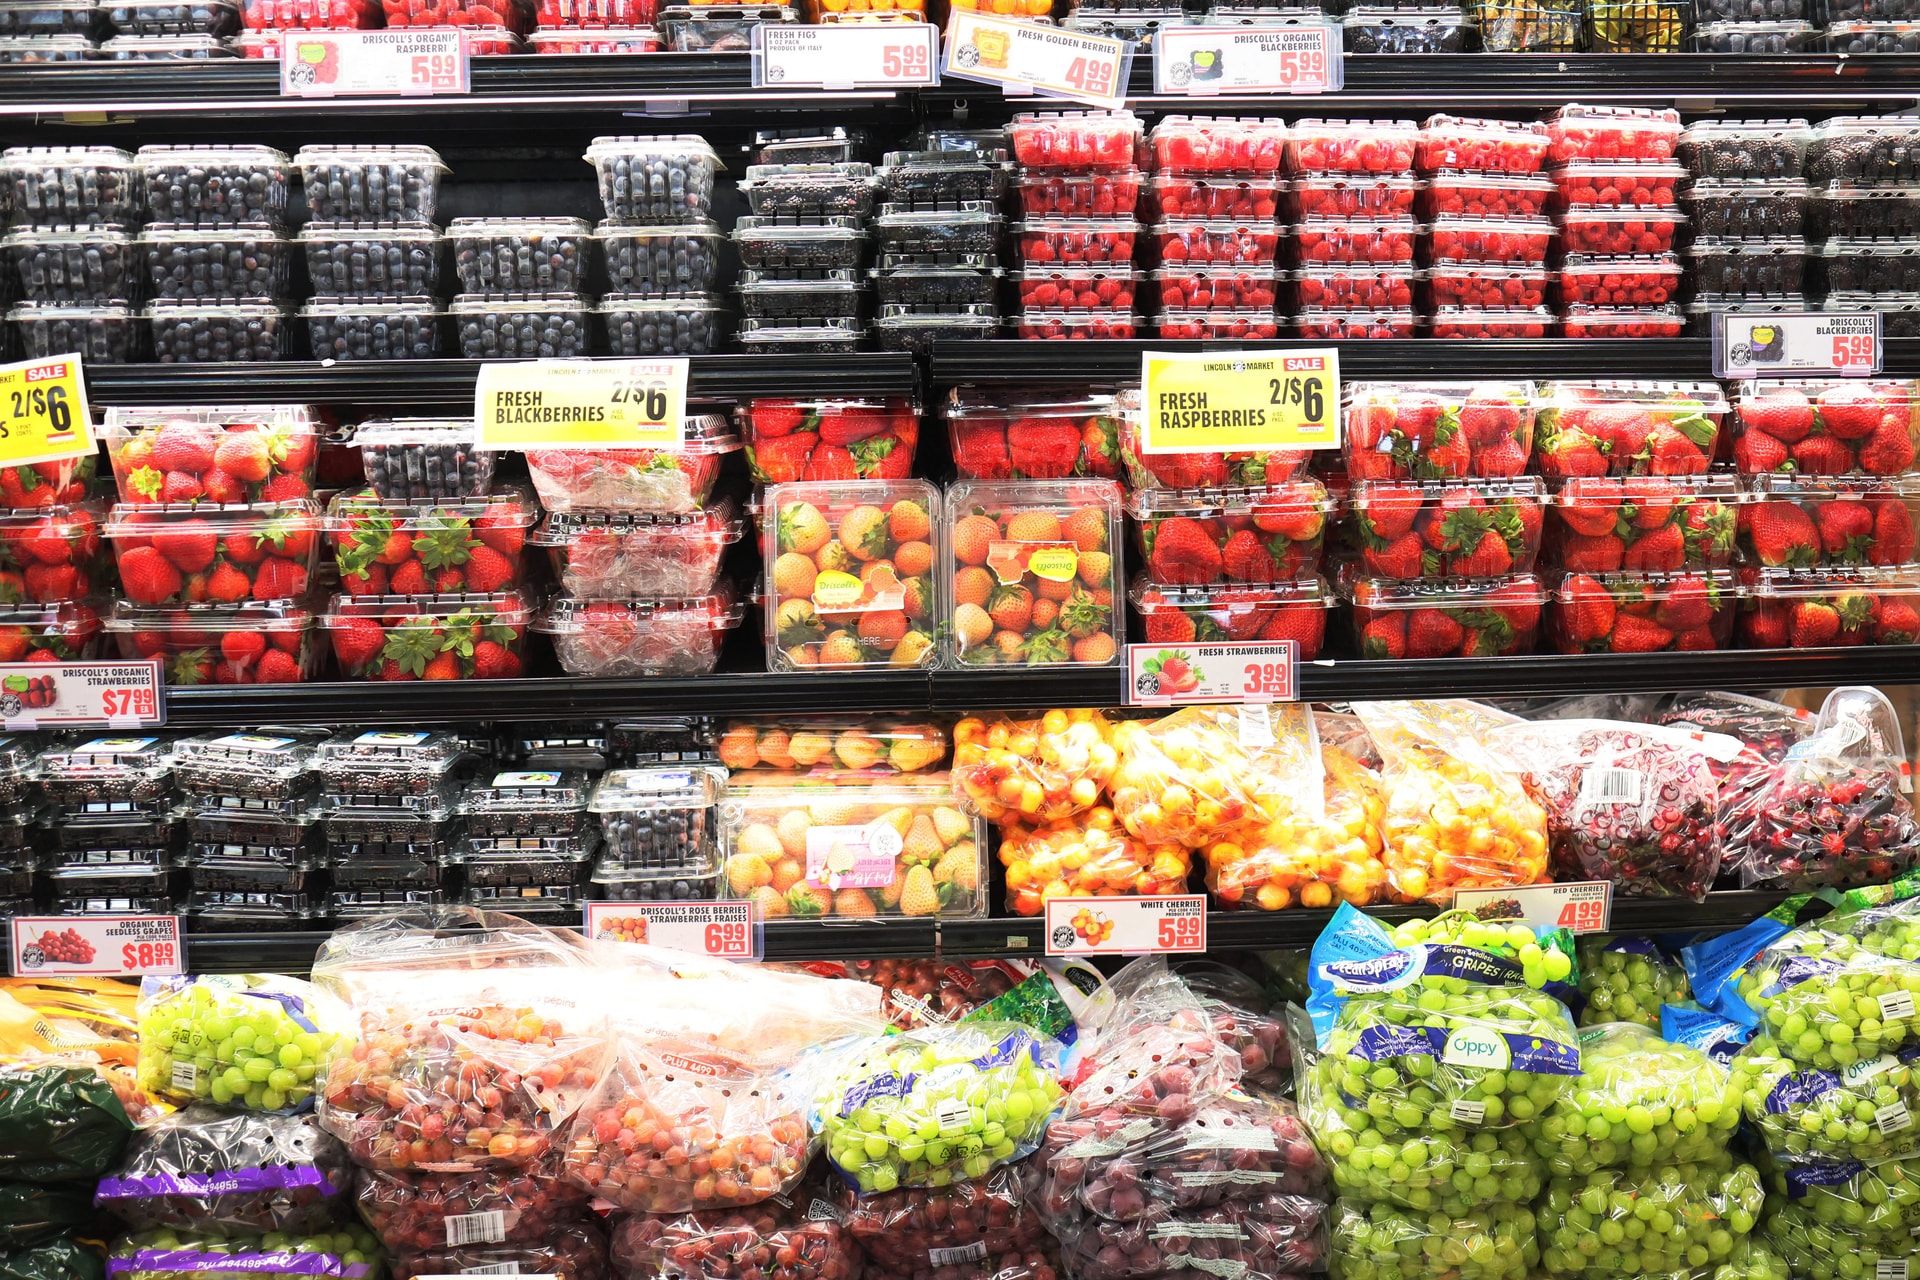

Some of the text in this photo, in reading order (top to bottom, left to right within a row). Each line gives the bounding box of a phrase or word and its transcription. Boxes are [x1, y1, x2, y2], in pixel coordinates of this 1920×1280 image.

[362, 34, 413, 44] DRISCOLL'S
[768, 31, 817, 39] FRESH FIGS
[1234, 33, 1321, 44] DRISCOLL'S ORGANIC
[1017, 28, 1117, 55] FRESH GOLDEN BERRIES
[1260, 42, 1322, 52] BLACKBERRIES
[909, 67, 921, 75] EA
[1830, 318, 1873, 327] DRISCOLL'S
[1816, 326, 1873, 335] BLACKBERRIES
[1203, 358, 1322, 372] LINCOLN MARKET SALE
[28, 365, 65, 381] SALE
[633, 366, 670, 376] SALE
[496, 391, 543, 406] FRESH
[610, 379, 668, 421] 2/$6
[1159, 392, 1208, 410] FRESH
[1269, 376, 1324, 422] 2/$6
[11, 385, 71, 432] 2/$6
[495, 406, 605, 424] BLACKBERRIES
[1160, 409, 1266, 429] RASPBERRIES
[857, 636, 881, 646] HERE
[1199, 646, 1288, 657] FRESH STRAWBERRIES
[62, 668, 150, 677] DRISCOLL'S ORGANIC
[87, 676, 151, 686] STRAWBERRIES
[1553, 885, 1604, 895] RED CHERRIES
[1140, 900, 1201, 909] WHITE CHERRIES
[640, 906, 747, 915] DRISCOLL'S ROSE BERRIES
[649, 914, 747, 923] STRAWBERRIES FRAISES
[119, 920, 173, 929] ORGANIC RED
[105, 929, 141, 937] SEEDLESS
[728, 943, 742, 951] EA
[1333, 934, 1348, 947] PLU
[1349, 943, 1369, 957] 4022
[1443, 946, 1494, 964] Green Seedless
[1452, 956, 1501, 978] GRAPES
[33, 1021, 69, 1049] ORGANIC
[643, 1026, 679, 1041] grapes
[1454, 1036, 1497, 1057] Oppy
[689, 1061, 712, 1075] 4499
[196, 1261, 217, 1270] PLU
